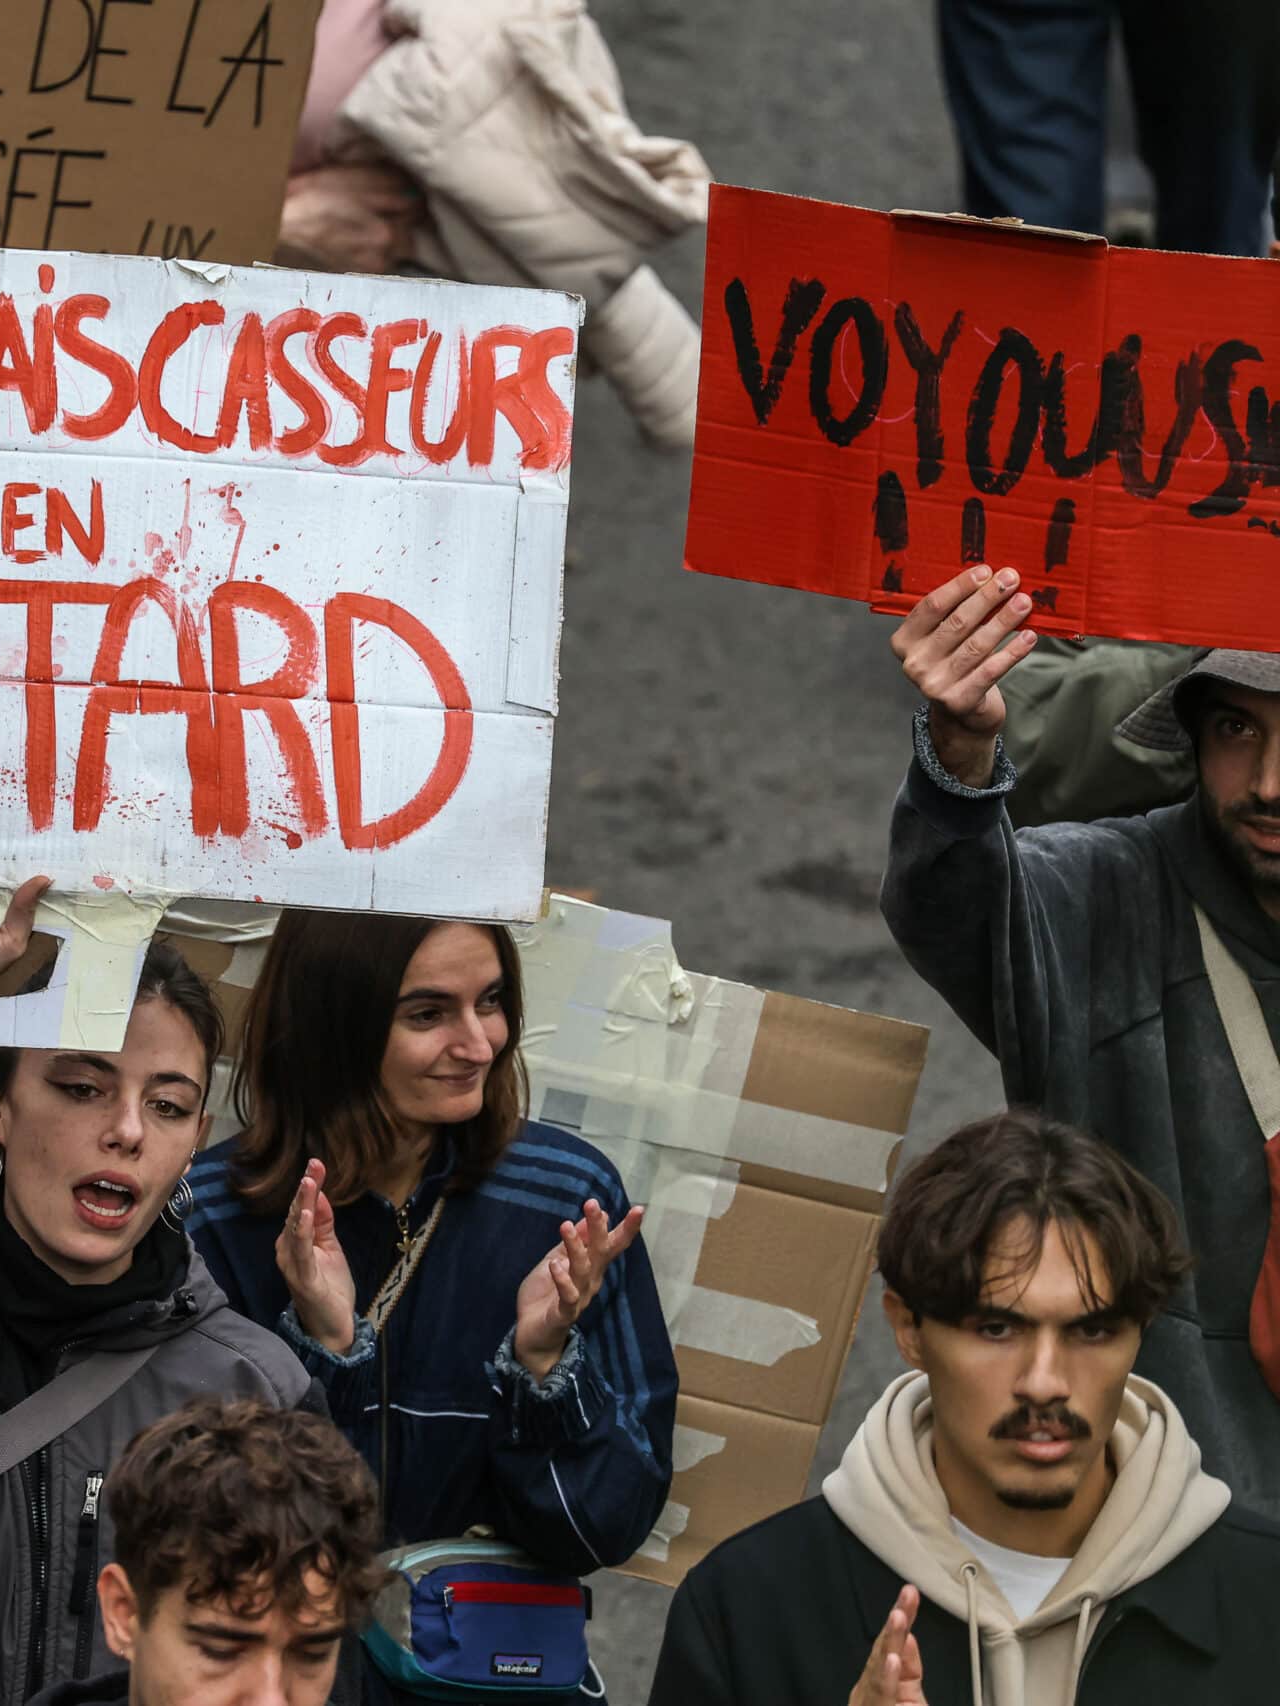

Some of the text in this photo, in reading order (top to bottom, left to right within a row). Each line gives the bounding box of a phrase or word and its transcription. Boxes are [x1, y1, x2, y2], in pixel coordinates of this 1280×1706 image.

[29, 0, 134, 105] DE
[166, 0, 283, 128] LA
[138, 299, 575, 471] CASSEURS
[1, 480, 106, 565] EN
[497, 1664, 538, 1674] patagonia
